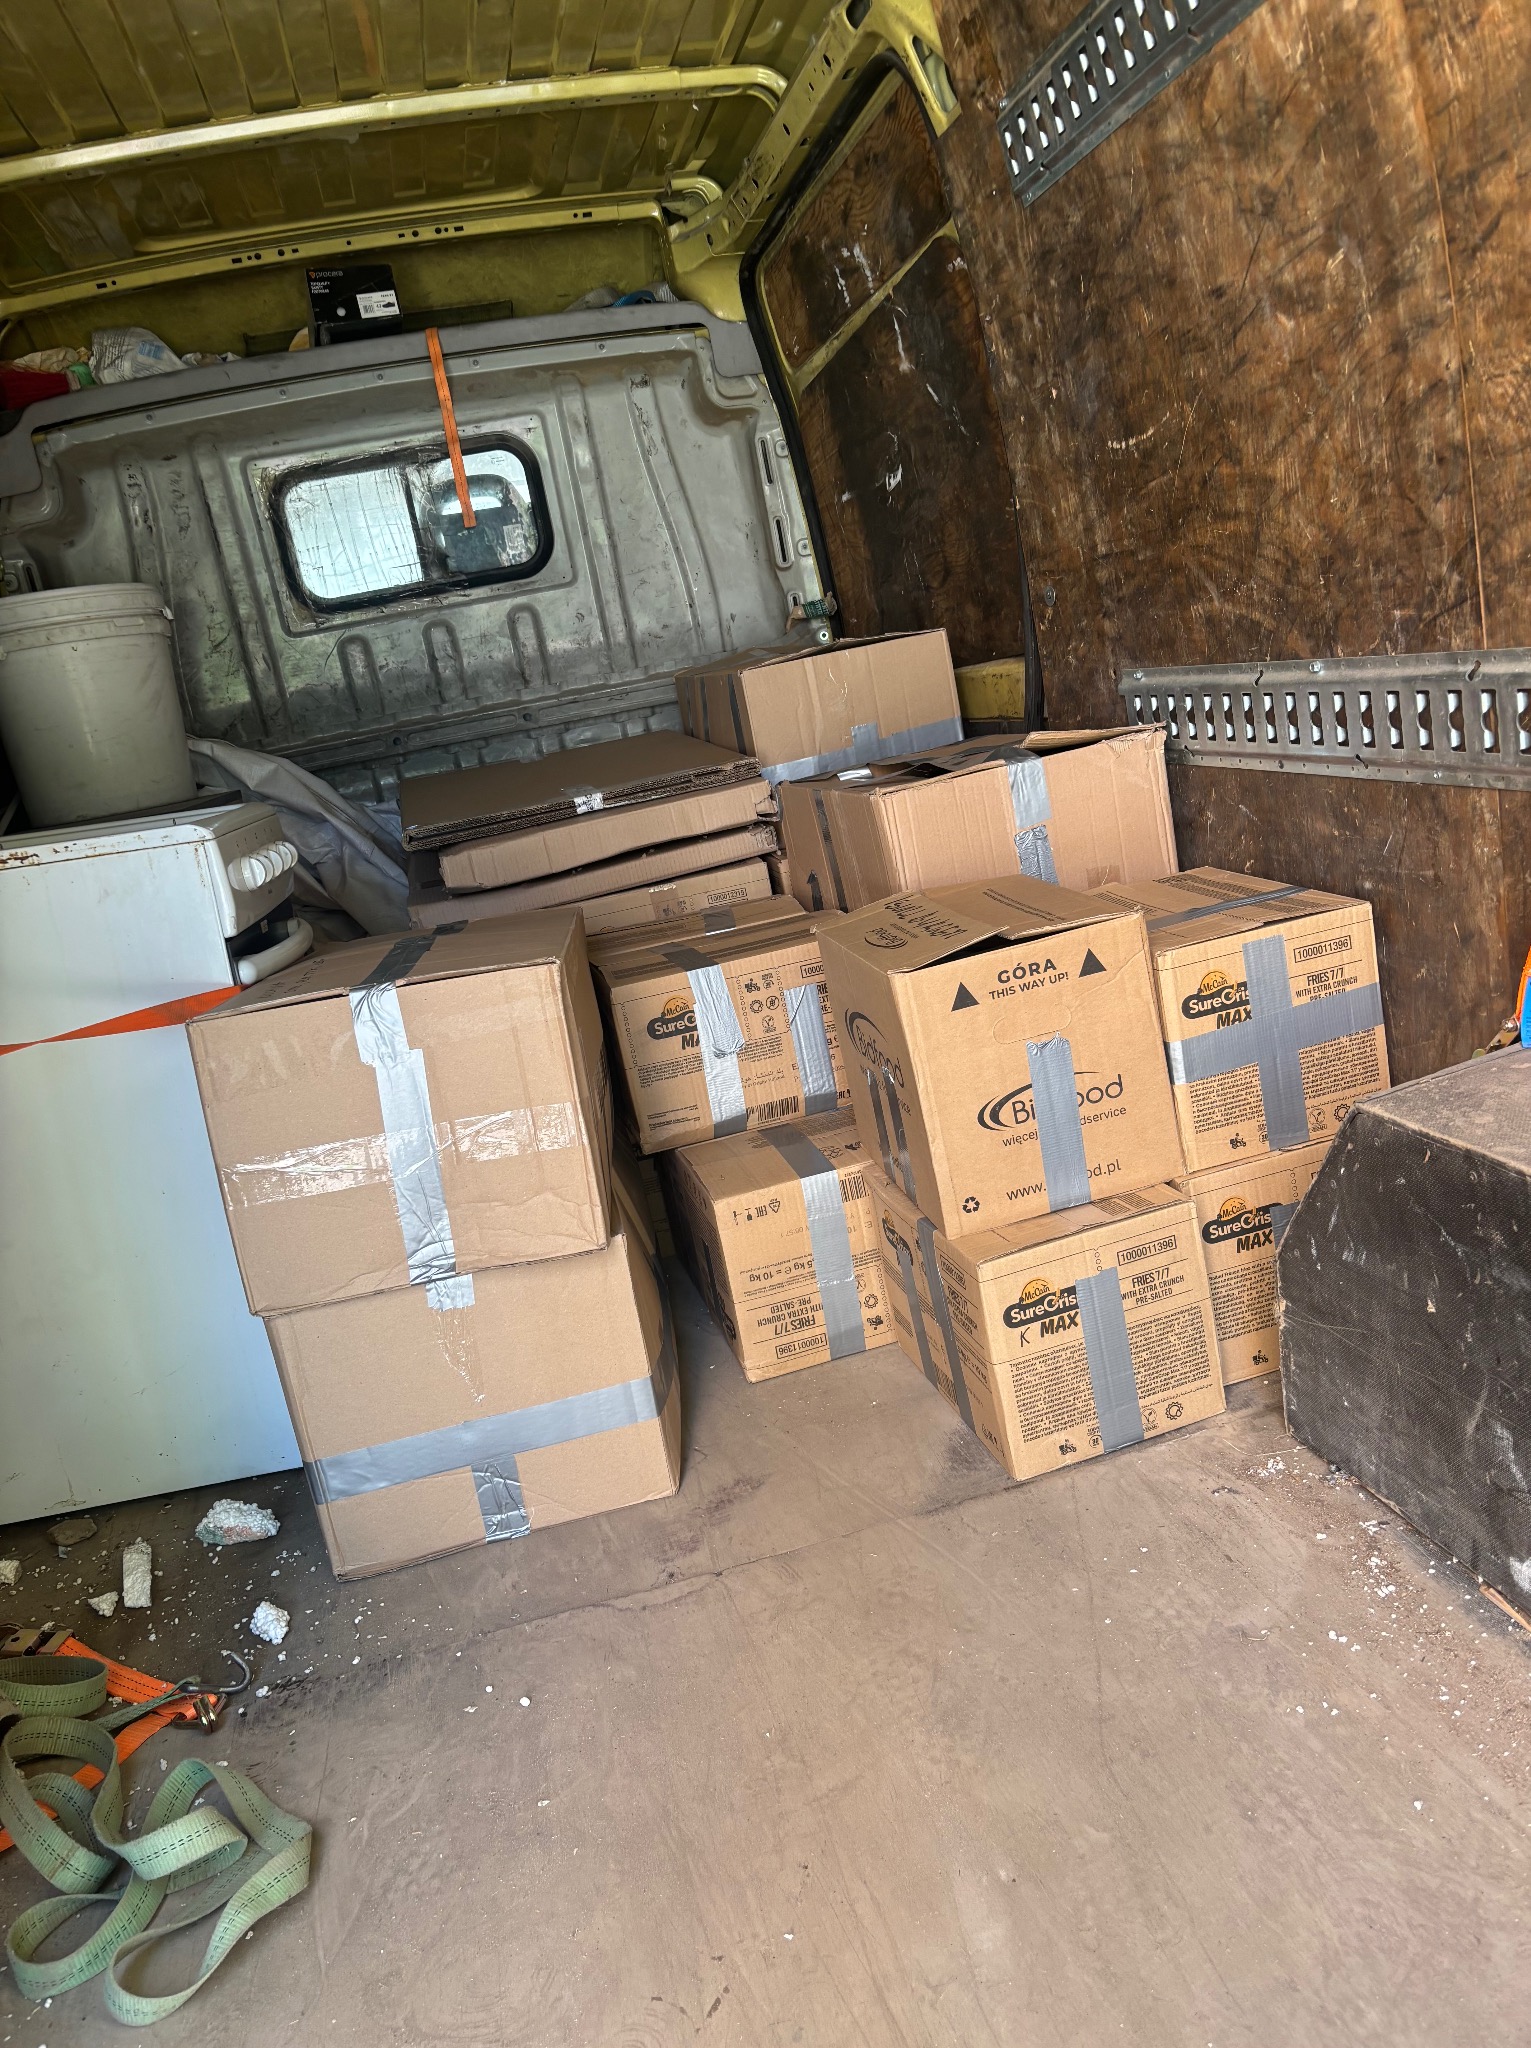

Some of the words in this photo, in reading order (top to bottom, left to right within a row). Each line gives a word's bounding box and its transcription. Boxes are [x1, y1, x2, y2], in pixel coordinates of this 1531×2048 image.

[1297, 939, 1349, 959] 1000011396
[804, 965, 824, 976] 10000
[996, 958, 1057, 985] GÓRA
[1307, 971, 1330, 986] FRIES
[1330, 967, 1344, 981] 7/7
[988, 986, 1016, 1001] THIS
[1017, 978, 1046, 993] WAY
[1048, 971, 1069, 986] UP!
[1202, 977, 1229, 994] McCain
[1295, 987, 1312, 998] WITH
[1312, 982, 1332, 994] EXTRA
[1332, 975, 1358, 989] CRUNCH
[1188, 984, 1251, 1014] SureCris
[665, 1002, 690, 1017] McCain
[1216, 1007, 1252, 1030] MAX
[653, 1016, 697, 1036] SureC
[681, 1034, 702, 1051] MA
[1011, 1074, 1124, 1125] Biod
[1080, 1106, 1127, 1126] dservice
[1002, 1128, 1039, 1147] więcej
[1222, 1205, 1247, 1219] McCain
[1208, 1208, 1272, 1239] SureCris
[1120, 1239, 1174, 1263] 1000011396
[1236, 1229, 1273, 1254] MAX
[763, 1270, 774, 1280] 10
[793, 1261, 805, 1271] kg
[749, 1273, 762, 1283] kg
[1132, 1273, 1154, 1289] FRIES
[1155, 1267, 1170, 1281] 7/7
[1023, 1284, 1051, 1301] McCain
[1121, 1288, 1137, 1301] WITH
[1137, 1283, 1157, 1296] EXTRA
[1157, 1275, 1184, 1291] CRUNCH
[1135, 1287, 1173, 1305] PRE-SALTED
[770, 1296, 812, 1313] PRE-SALTED
[807, 1303, 824, 1317] ITH
[1009, 1292, 1077, 1324] SureCris
[757, 1311, 787, 1328] CRUNCH
[788, 1307, 808, 1322] EXTRA
[789, 1314, 816, 1331] FRIES
[774, 1320, 788, 1336] 7/7
[1039, 1311, 1079, 1338] MAX
[778, 1336, 825, 1356] 1000011396
